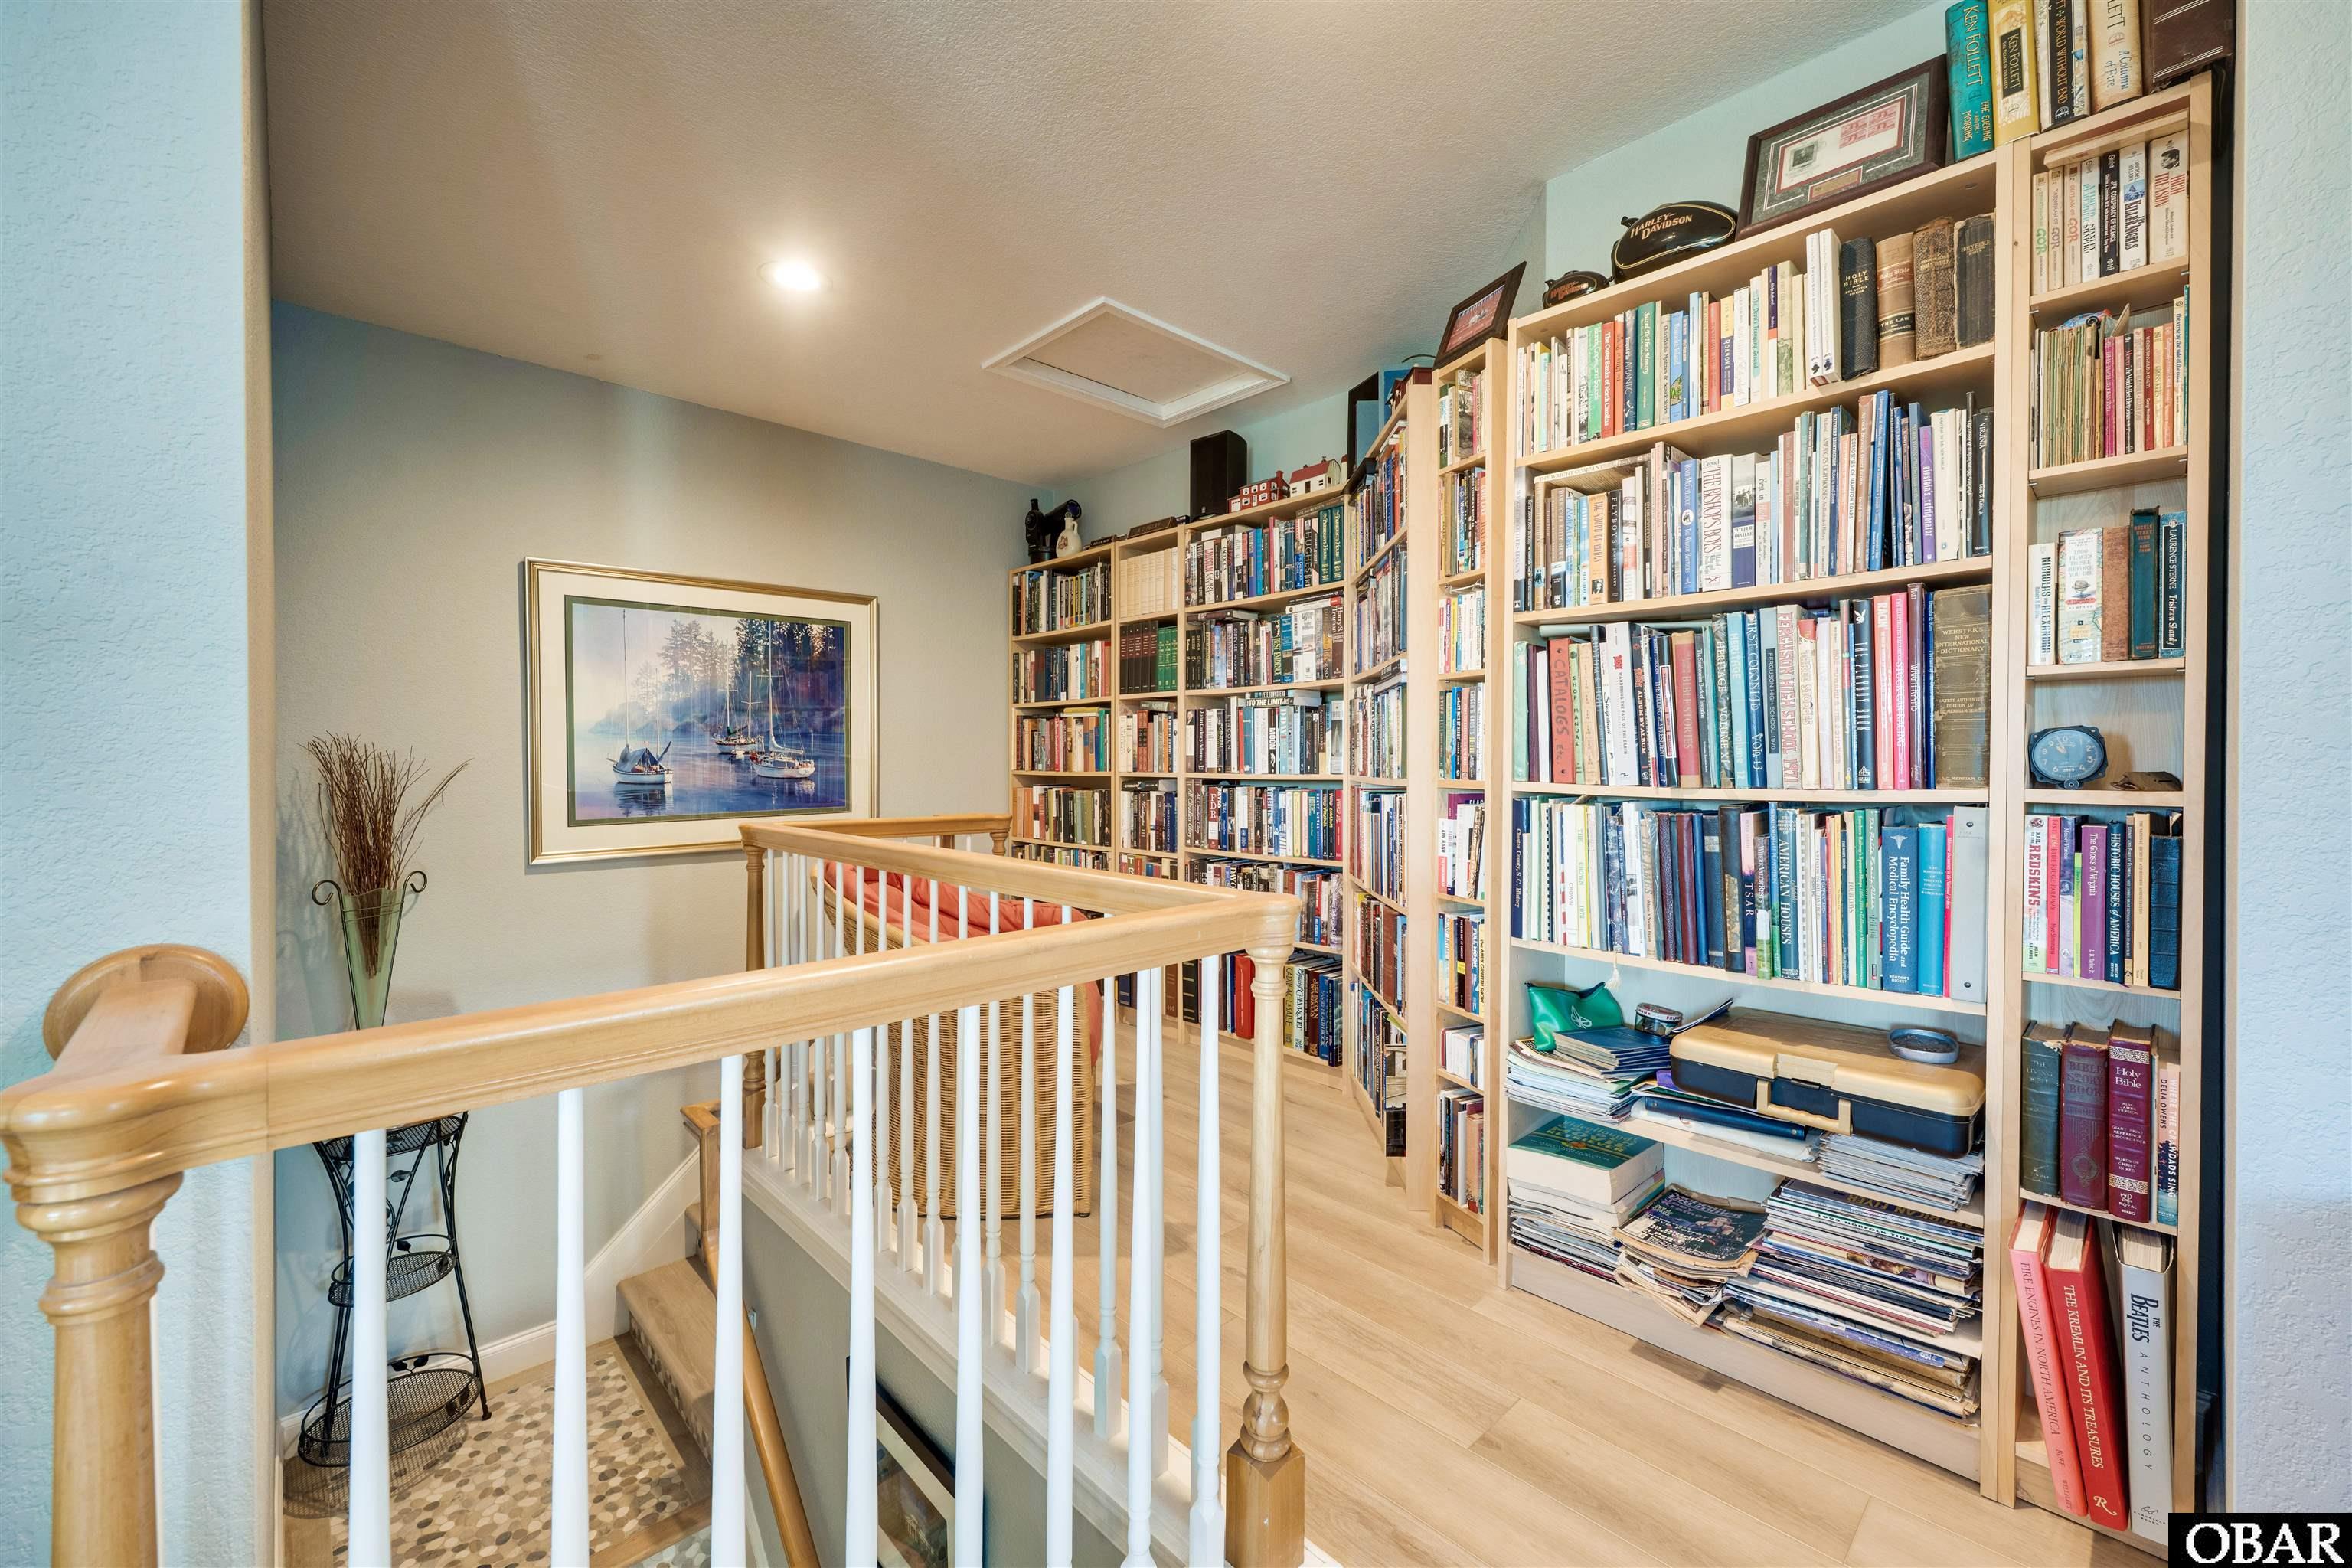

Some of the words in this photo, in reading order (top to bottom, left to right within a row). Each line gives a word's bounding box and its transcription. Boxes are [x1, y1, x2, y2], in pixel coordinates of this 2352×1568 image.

[1963, 5, 1978, 31] KEN
[2007, 34, 2020, 53] KEN
[2056, 17, 2066, 47] WORLD
[1965, 33, 1983, 86] FOLLETT
[2009, 54, 2021, 89] FOLLETT
[2056, 47, 2068, 85] WITHOUT
[1981, 100, 1990, 113] THE
[2057, 87, 2068, 104] END
[1961, 110, 1972, 142] MORNING
[1981, 115, 1991, 141] EVENING
[2154, 172, 2170, 207] TREASON
[2170, 174, 2185, 195] HIGH
[1642, 214, 1693, 240] DAVIDSON
[2036, 228, 2047, 256] GOR
[1844, 276, 1869, 287] BIBLE
[1845, 270, 1867, 282] HOLY
[1625, 362, 1633, 394] ATLANTIC
[1703, 467, 1721, 488] THE
[1759, 478, 1768, 492] First
[1923, 466, 1933, 495] einstein's
[1703, 488, 1721, 528] BISHOP'S
[1923, 499, 1933, 537] refrigerator
[1703, 530, 1721, 554] BOYS
[2168, 528, 2177, 564] LAURENCE
[2168, 565, 2177, 590] STERNE
[2168, 594, 2177, 621] Tristram
[1777, 613, 1795, 675] FERGUSON
[1942, 626, 1984, 636] WEBSTER'S
[2165, 621, 2177, 645] Shandy
[1273, 651, 1282, 675] EVIDENCE
[1855, 642, 1868, 657] THE
[1940, 646, 1987, 655] DICTIONARY
[1682, 676, 1692, 705] BIBLE
[1780, 678, 1796, 707] HIGH
[1856, 664, 1869, 702] PLAYBOY
[1603, 692, 1612, 735] Slingerland
[1638, 717, 1645, 727] BY
[1857, 709, 1870, 731] BOOK
[1683, 707, 1693, 750] STORIES
[1782, 710, 1796, 754] SCHOOL
[1782, 759, 1799, 783] 1971
[2089, 845, 2098, 865] Ghosts
[2110, 833, 2121, 872] HISTORIC
[1779, 839, 1790, 897] AMERICAN
[1889, 856, 1898, 894] Medical
[1899, 857, 1909, 889] Family
[2028, 845, 2040, 906] REDSKINS
[2088, 874, 2098, 896] Virginia
[2110, 874, 2121, 907] HOUSES
[1745, 883, 1754, 916] TSAR
[1900, 891, 1910, 923] Health
[2110, 908, 2122, 918] of
[1781, 903, 1792, 945] HOUSES
[1887, 897, 1898, 962] Encyclopedia
[2110, 918, 2120, 955] AMERICA
[1900, 926, 1909, 955] Guide
[2068, 1074, 2103, 1086] STORY
[2069, 1061, 2102, 1073] BIBLE
[2115, 1067, 2141, 1079] Holy
[2070, 1085, 2102, 1097] BOOK
[2115, 1076, 2142, 1089] Bible
[2160, 1079, 2168, 1103] DELIA
[2168, 1129, 2177, 1171] CRAWDADS
[2167, 1173, 2177, 1198] SING
[2118, 1201, 2138, 1210] ROYAL
[2020, 1262, 2034, 1285] FIRE
[2025, 1287, 2042, 1331] ENGINES
[2063, 1285, 2077, 1307] THE
[2127, 1293, 2159, 1344] BEATLES
[2152, 1316, 2161, 1328] THE
[2033, 1334, 2043, 1346] IN
[2067, 1310, 2086, 1361] KREMLIN
[2034, 1347, 2052, 1386] NORTH
[2076, 1361, 2090, 1387] AND
[2080, 1389, 2093, 1405] ITS
[2043, 1389, 2061, 1436] AMERICA
[2138, 1351, 2153, 1471] ANTHOLOGY
[2083, 1406, 2104, 1469] TREASURES
